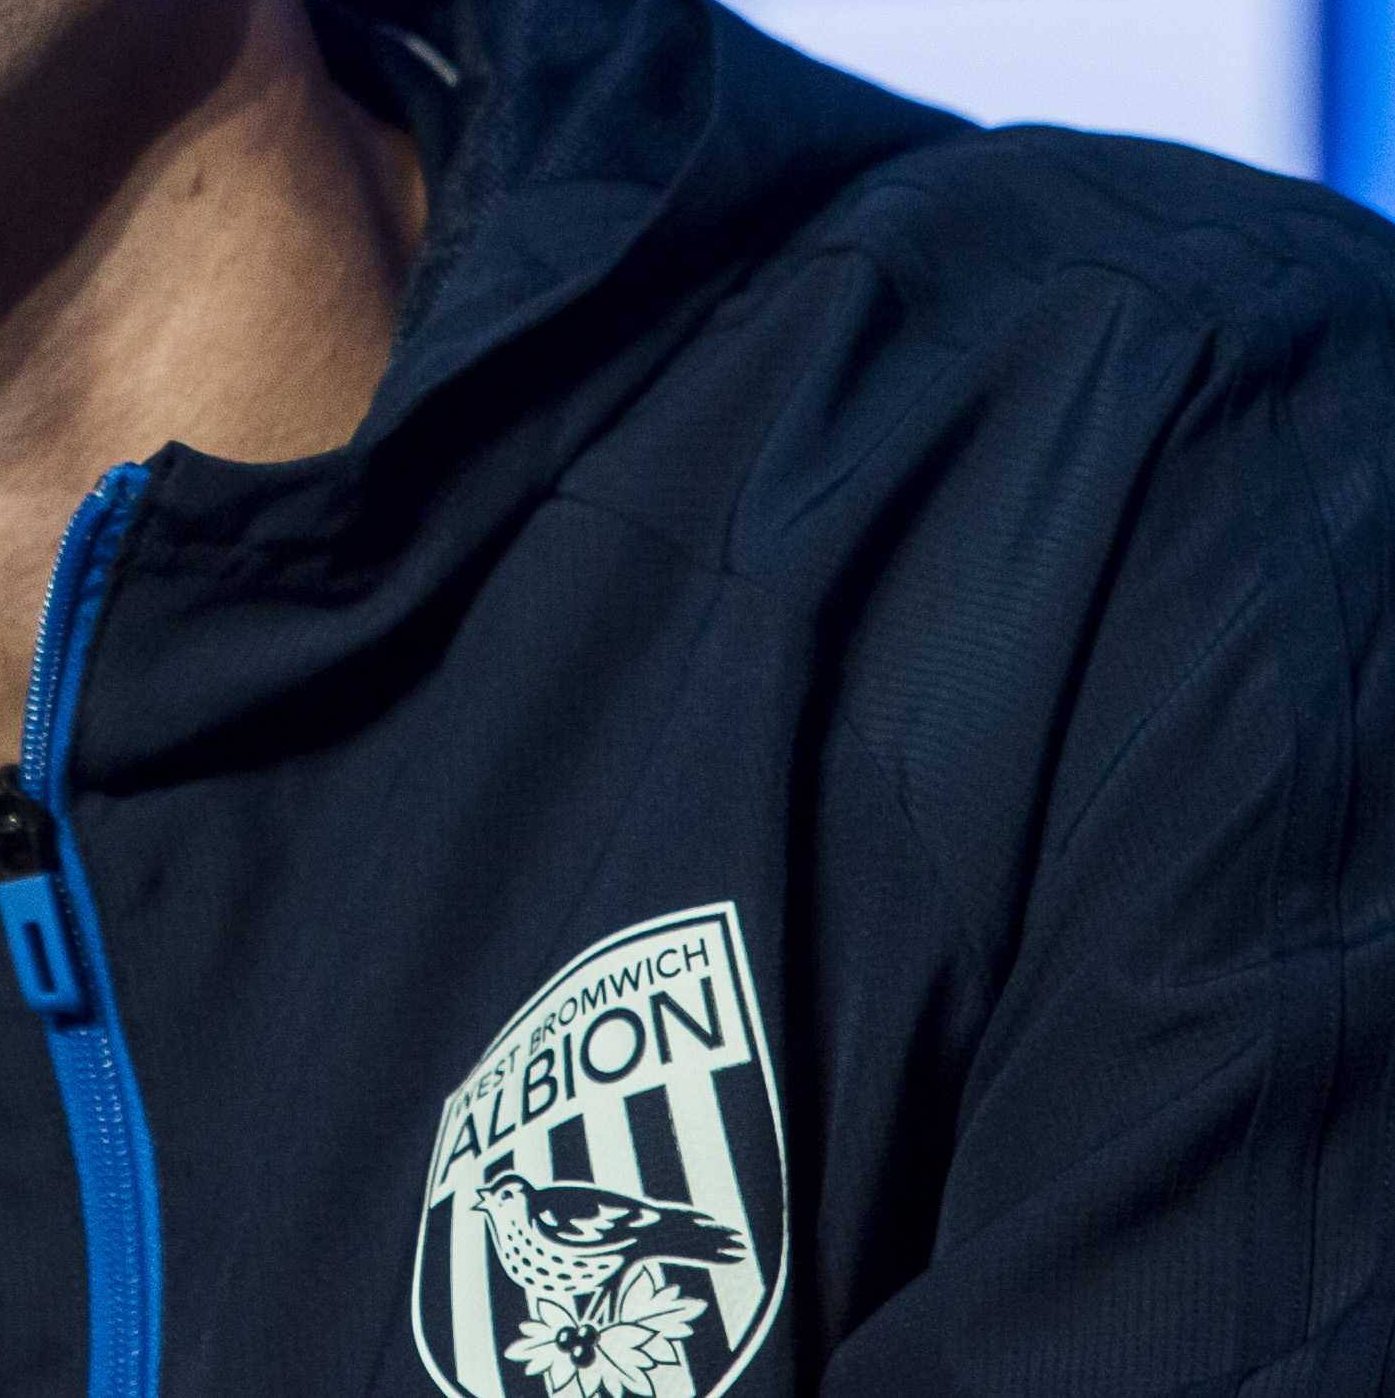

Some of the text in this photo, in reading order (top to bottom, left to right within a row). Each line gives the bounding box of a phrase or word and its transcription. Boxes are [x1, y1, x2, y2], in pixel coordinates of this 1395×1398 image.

[438, 975, 727, 1187] ALBION
[454, 937, 710, 1119] WEST BROMWICH
